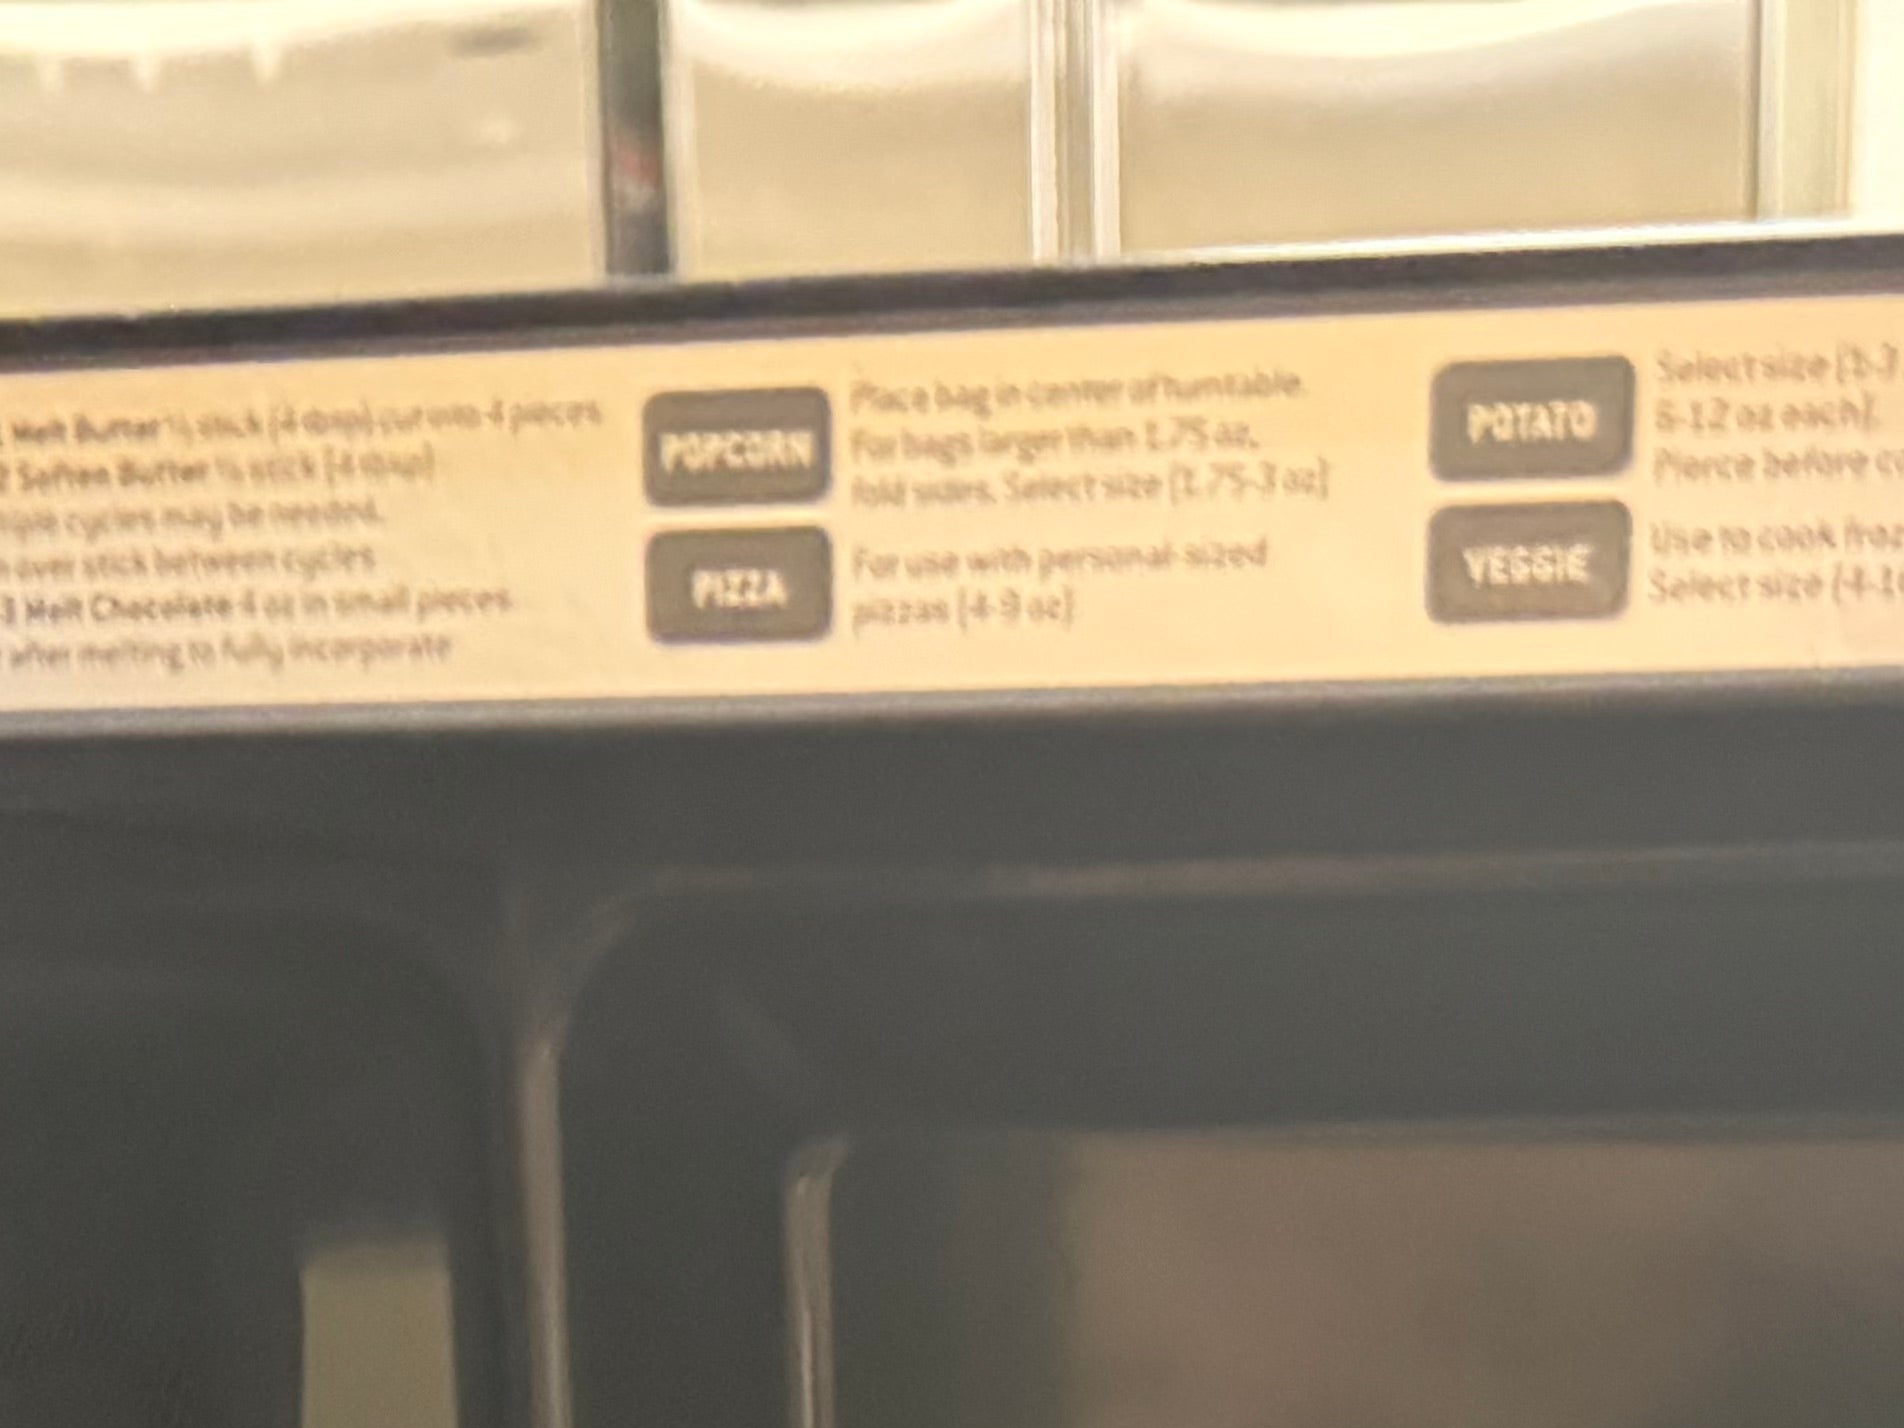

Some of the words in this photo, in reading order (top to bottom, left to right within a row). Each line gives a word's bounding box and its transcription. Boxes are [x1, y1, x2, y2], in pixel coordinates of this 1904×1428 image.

[1656, 350, 1755, 384] Select
[1761, 352, 1829, 382] size
[934, 377, 991, 421] bag
[1467, 400, 1597, 445] POTATO
[659, 430, 816, 474] POPCORN
[900, 427, 975, 469] bags
[1654, 447, 1757, 484] Pierce
[1762, 444, 1870, 479] before
[1001, 469, 1097, 502] Select
[1650, 520, 1713, 555] Use
[1756, 517, 1837, 549] cook
[903, 551, 959, 579] use
[964, 546, 1033, 574] with
[1462, 543, 1594, 590] VEGGIE
[692, 568, 788, 610] PIZZA
[1648, 565, 1751, 604] Select
[1756, 564, 1824, 601] size
